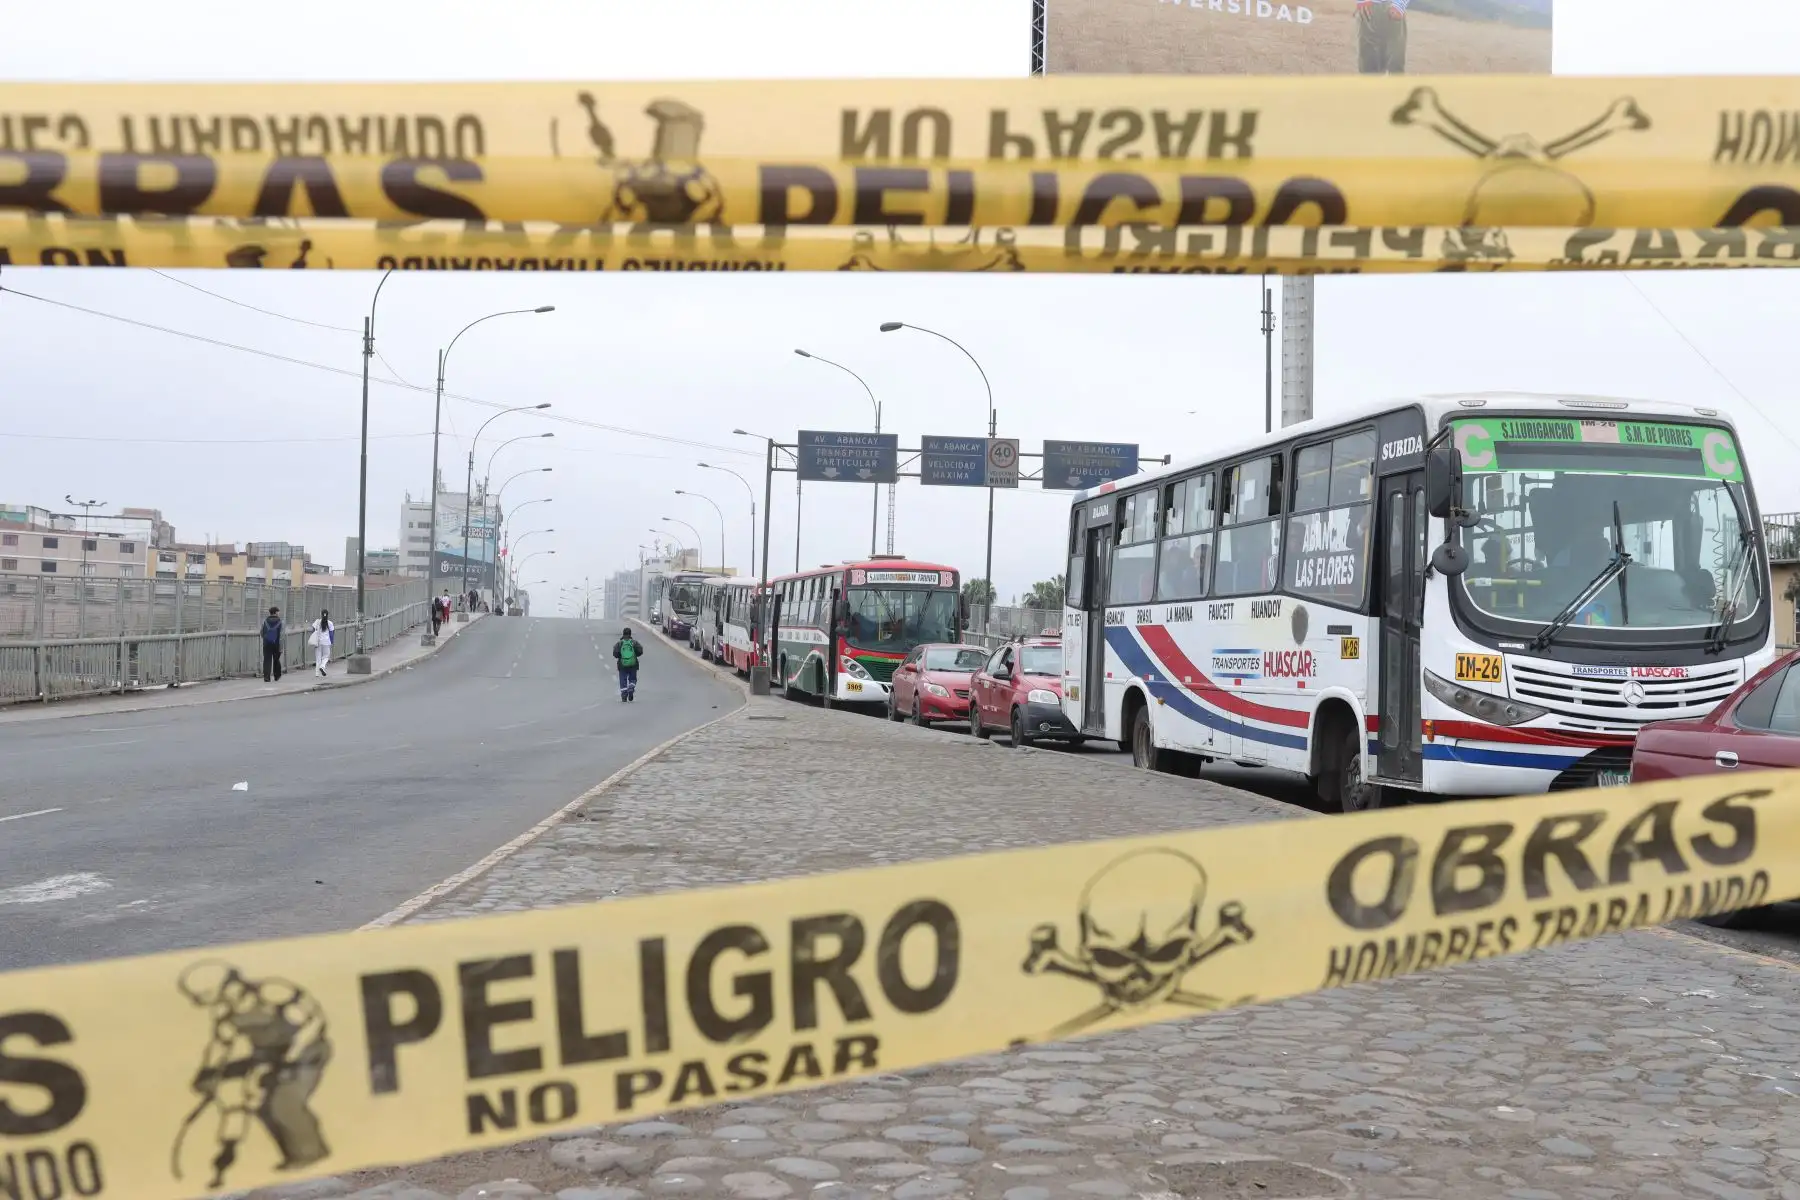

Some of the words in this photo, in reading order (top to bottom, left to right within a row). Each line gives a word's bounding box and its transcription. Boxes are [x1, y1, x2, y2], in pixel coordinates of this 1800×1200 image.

[837, 436, 879, 445] ABANCAY
[1645, 427, 1658, 444] DE
[1658, 428, 1693, 446] PORRES
[815, 448, 880, 457] TRANSPORTE
[943, 442, 981, 451] ABANCAY
[994, 447, 1011, 458] 40
[1381, 434, 1424, 460] SUBIDA
[1453, 424, 1494, 468] C
[1703, 431, 1738, 475] C
[816, 458, 878, 467] PARTICULAR
[928, 460, 976, 470] VELOCIDAD
[932, 471, 969, 480] MAXIMA
[851, 569, 866, 586] B
[939, 571, 954, 588] B
[1295, 559, 1314, 587] LAS
[1315, 554, 1355, 586] FLORES
[1136, 608, 1153, 624] BRASIL
[1166, 607, 1172, 623] LA
[1174, 605, 1193, 623] MARINA
[1208, 603, 1235, 621] FAUCETT
[1250, 599, 1282, 619] HUANDOY
[1211, 656, 1261, 670] TRANSPORTES
[1263, 650, 1312, 677] HUASCAR
[1457, 656, 1500, 679] IM-26
[1572, 666, 1628, 675] TRANSPORTES
[1630, 666, 1685, 678] HUASCAR
[1326, 787, 1774, 931] OBRAS
[360, 897, 960, 1095] PELIGRO
[466, 1080, 579, 1134] NO
[615, 1034, 881, 1111] PASAR
